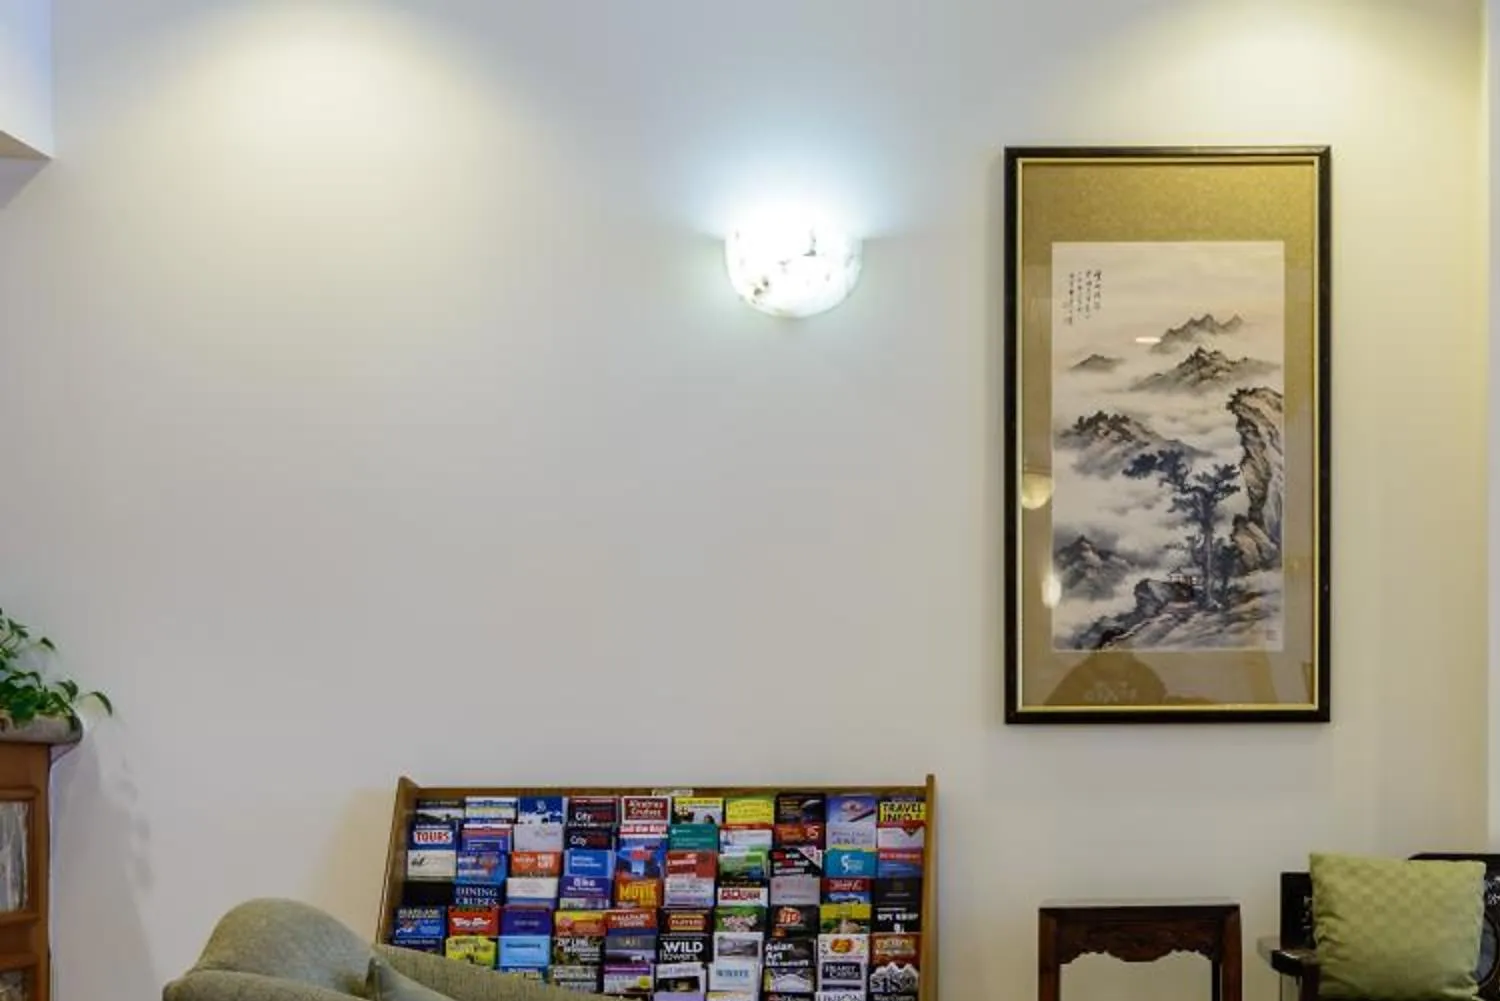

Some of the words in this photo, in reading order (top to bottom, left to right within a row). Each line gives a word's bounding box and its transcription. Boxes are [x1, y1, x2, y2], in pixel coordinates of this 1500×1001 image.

[416, 831, 449, 842] TOURS
[664, 941, 703, 953] WILD
[765, 942, 794, 952] Asian
